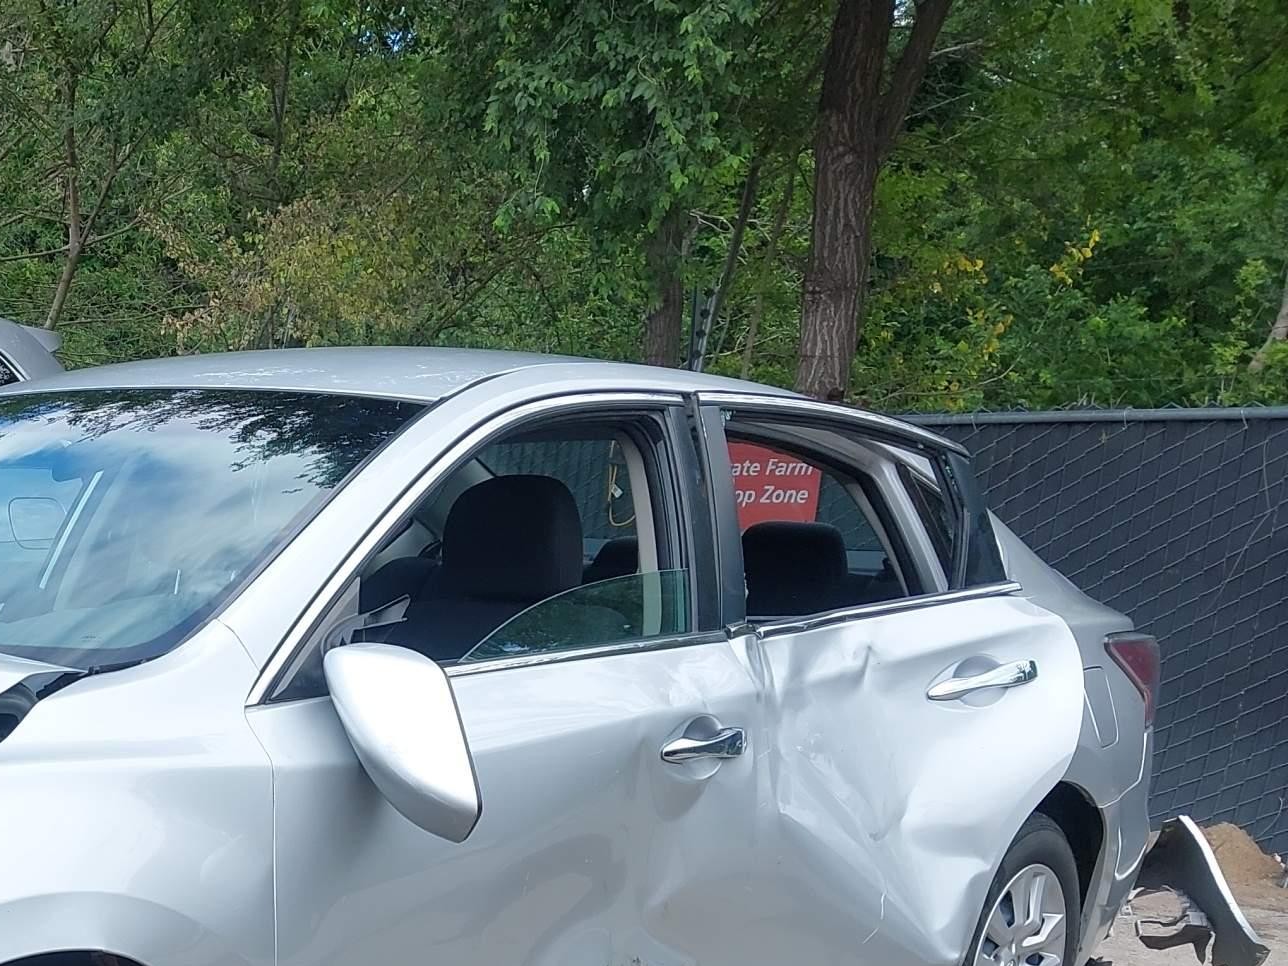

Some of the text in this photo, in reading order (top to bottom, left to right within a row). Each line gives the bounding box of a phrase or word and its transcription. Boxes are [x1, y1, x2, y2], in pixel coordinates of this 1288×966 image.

[731, 459, 813, 476] ate Farm
[759, 485, 809, 503] Zone
